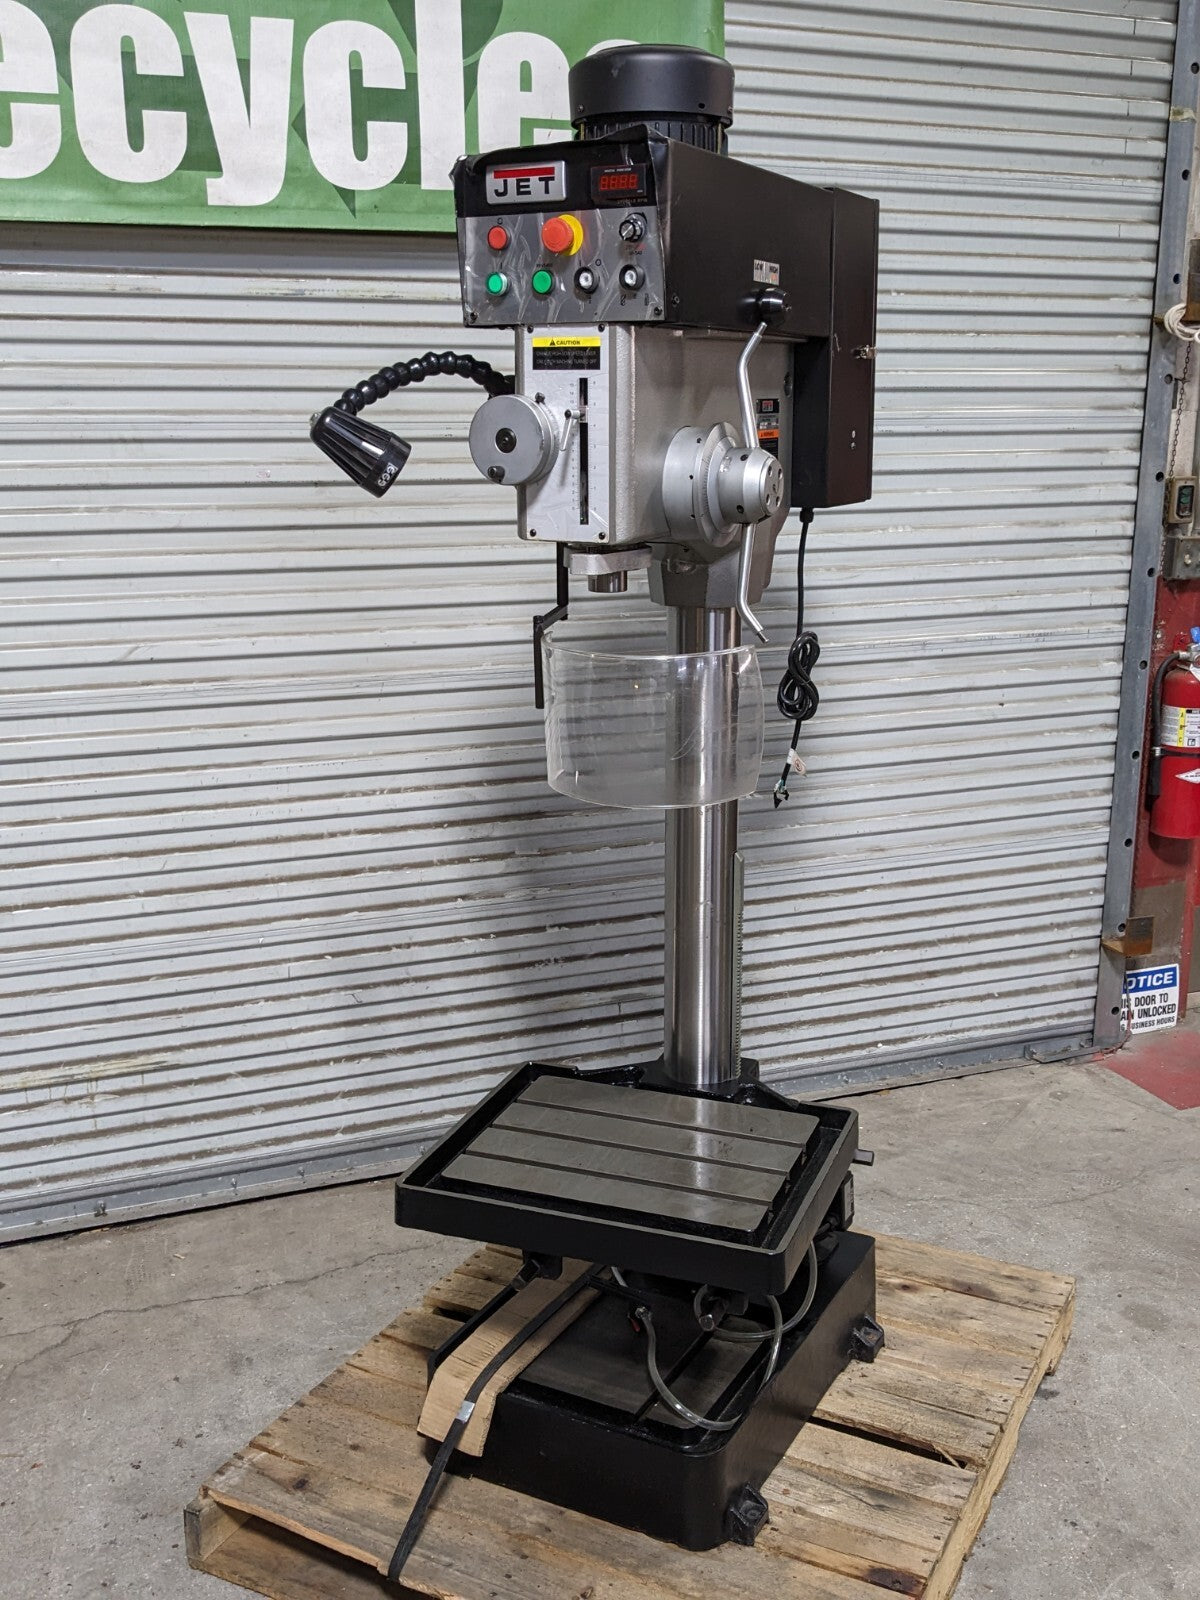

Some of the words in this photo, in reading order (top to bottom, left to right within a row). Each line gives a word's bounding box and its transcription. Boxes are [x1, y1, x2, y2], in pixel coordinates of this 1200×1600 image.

[0, 0, 648, 207] ecycle
[493, 176, 556, 197] JET
[1126, 971, 1174, 990] OTICE
[1134, 995, 1156, 1008] DOOR
[1159, 992, 1169, 1004] TO
[1137, 1003, 1176, 1019] UNLOCKED
[1131, 1019, 1155, 1030] USINESS
[1156, 1015, 1175, 1026] HOURS
